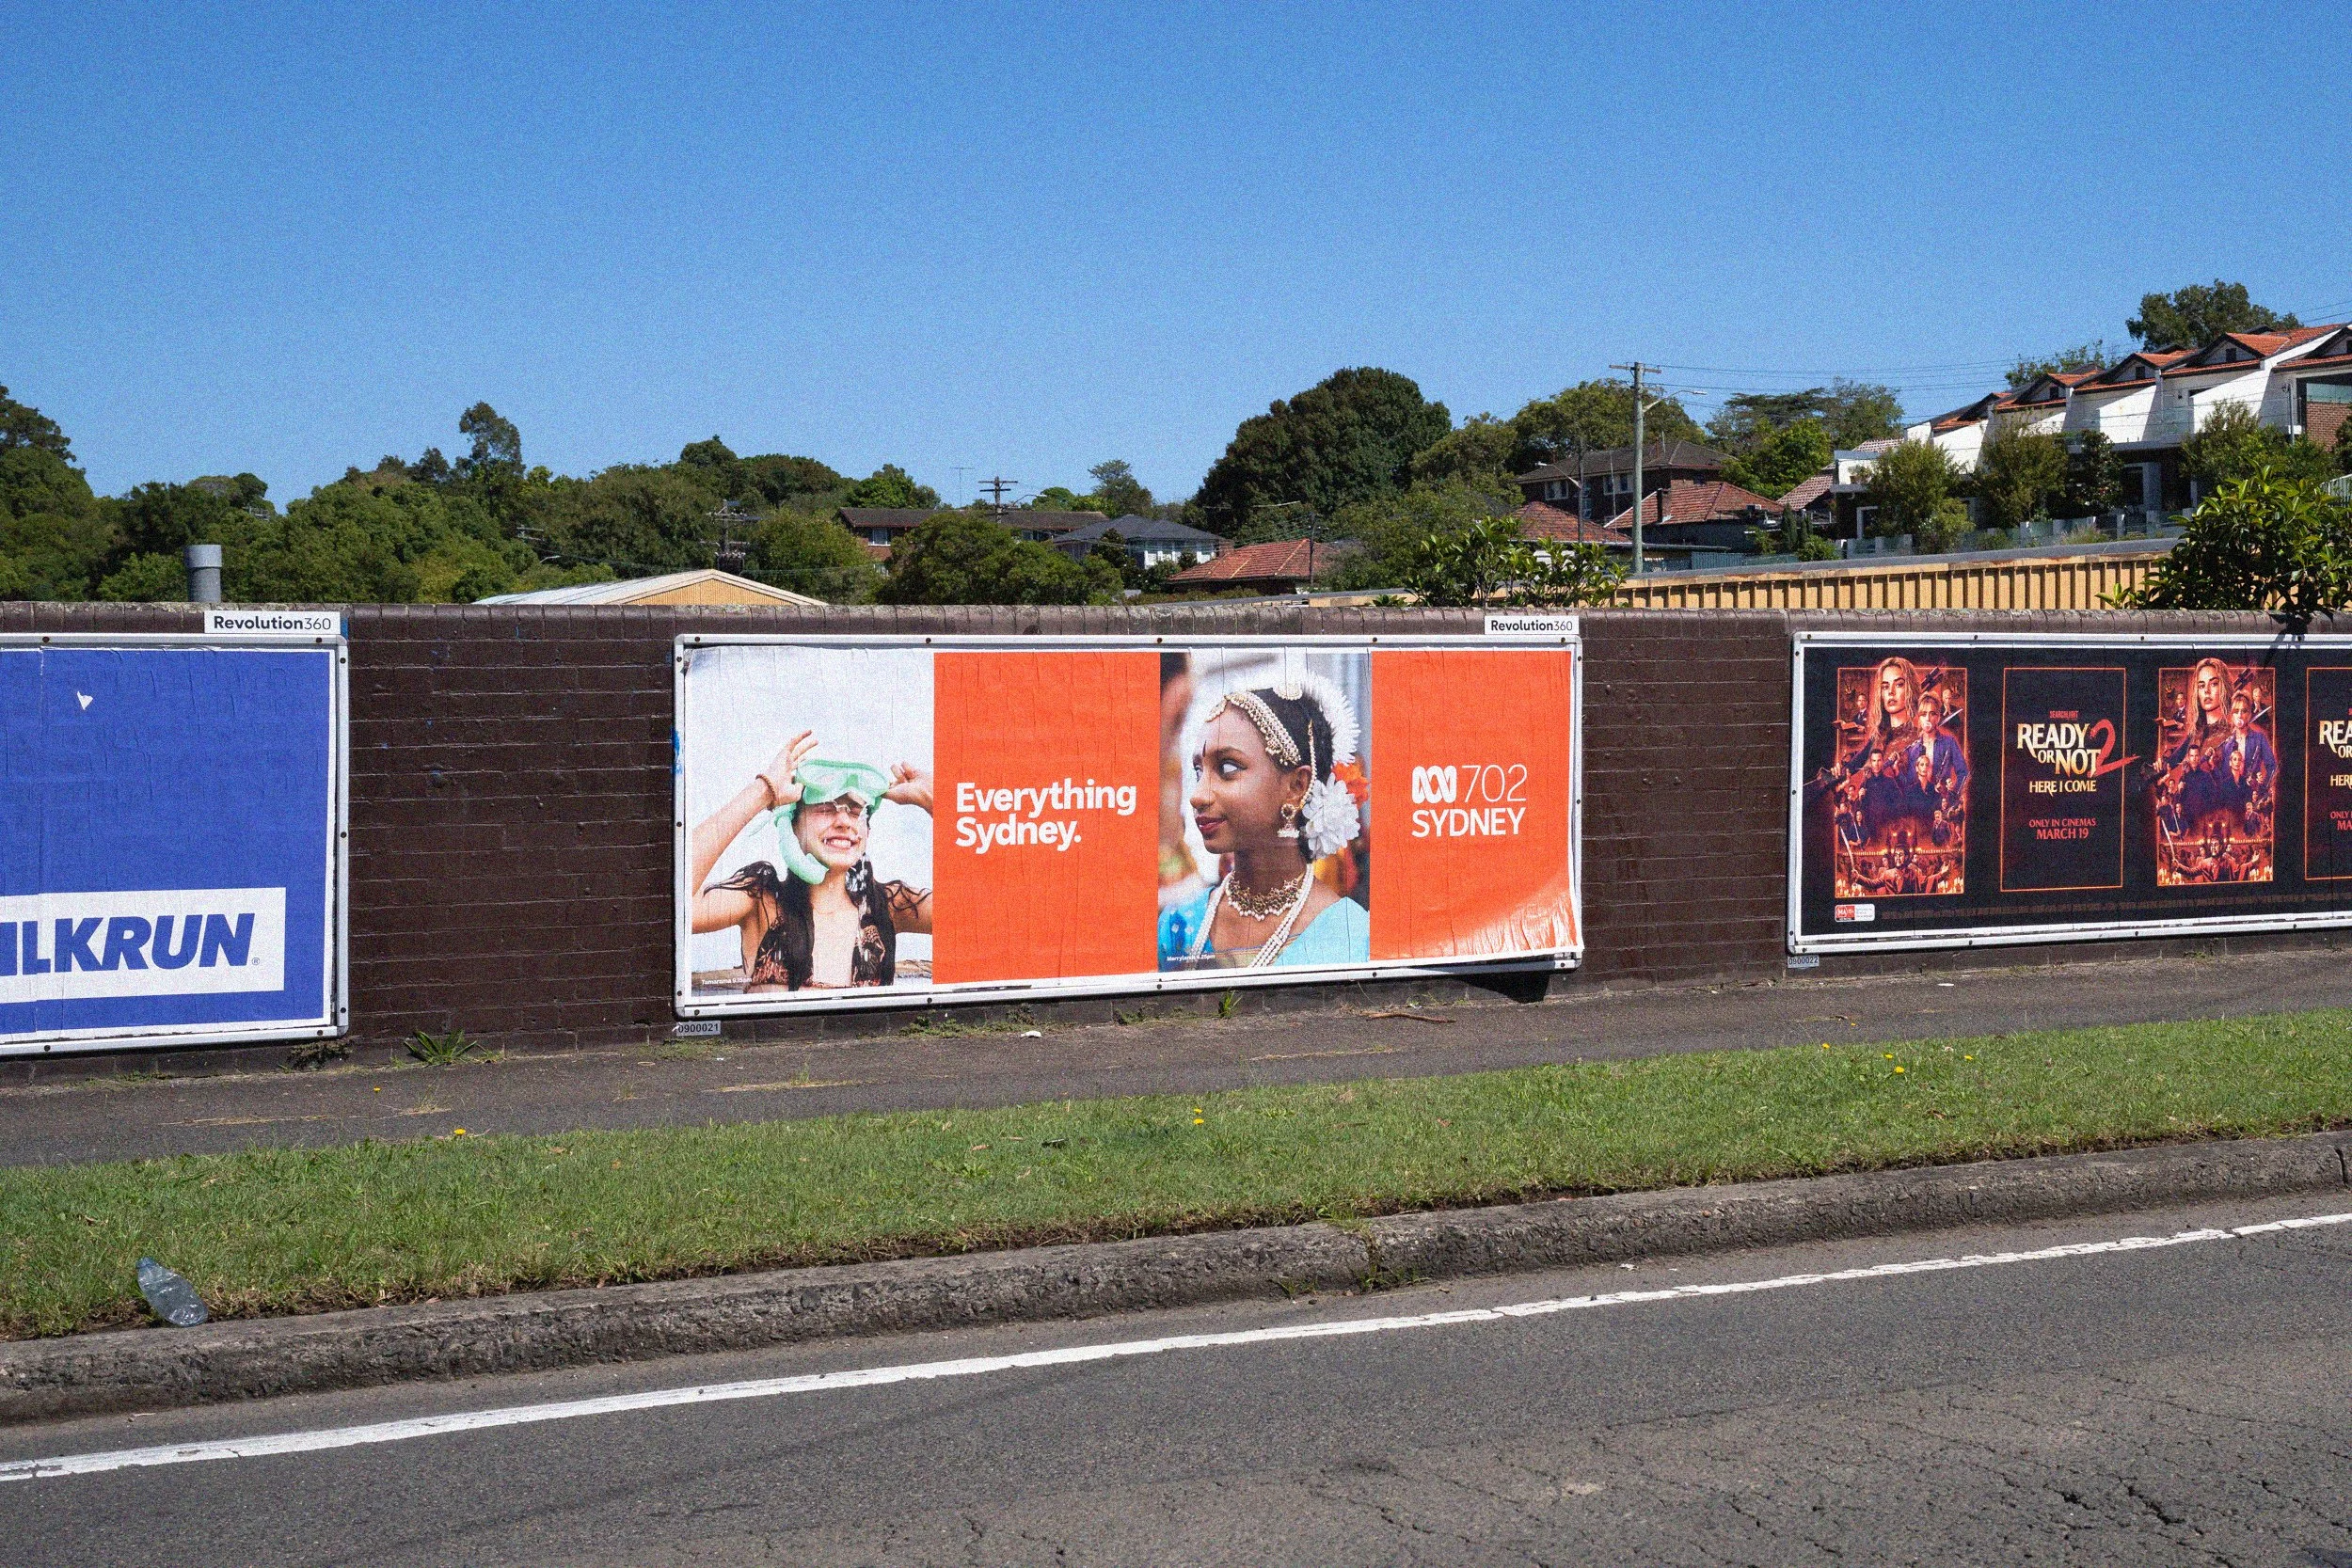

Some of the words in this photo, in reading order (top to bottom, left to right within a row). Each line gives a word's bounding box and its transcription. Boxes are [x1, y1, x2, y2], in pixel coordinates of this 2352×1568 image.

[214, 615, 331, 630] Revolution360
[1491, 619, 1573, 631] Revolution360
[2017, 723, 2090, 758] READY
[2038, 750, 2056, 764] OR
[2055, 749, 2102, 778] NOT
[2087, 718, 2141, 778] 2
[1461, 763, 1528, 802] 702
[2029, 781, 2058, 797] HERE
[2059, 780, 2063, 792] I
[2065, 780, 2097, 792] COME
[957, 777, 1136, 818] Everything
[1411, 807, 1527, 837] SYDNEY
[2029, 819, 2050, 828] ONLY
[2052, 818, 2060, 827] IN
[2062, 817, 2097, 827] CINEMAS
[2330, 811, 2348, 819] ONLY
[955, 813, 1082, 854] Sydney.
[2036, 829, 2075, 840] MARCH
[2079, 828, 2089, 839] 19
[1788, 956, 1819, 965] 0900022
[678, 1023, 718, 1033] 0900021
